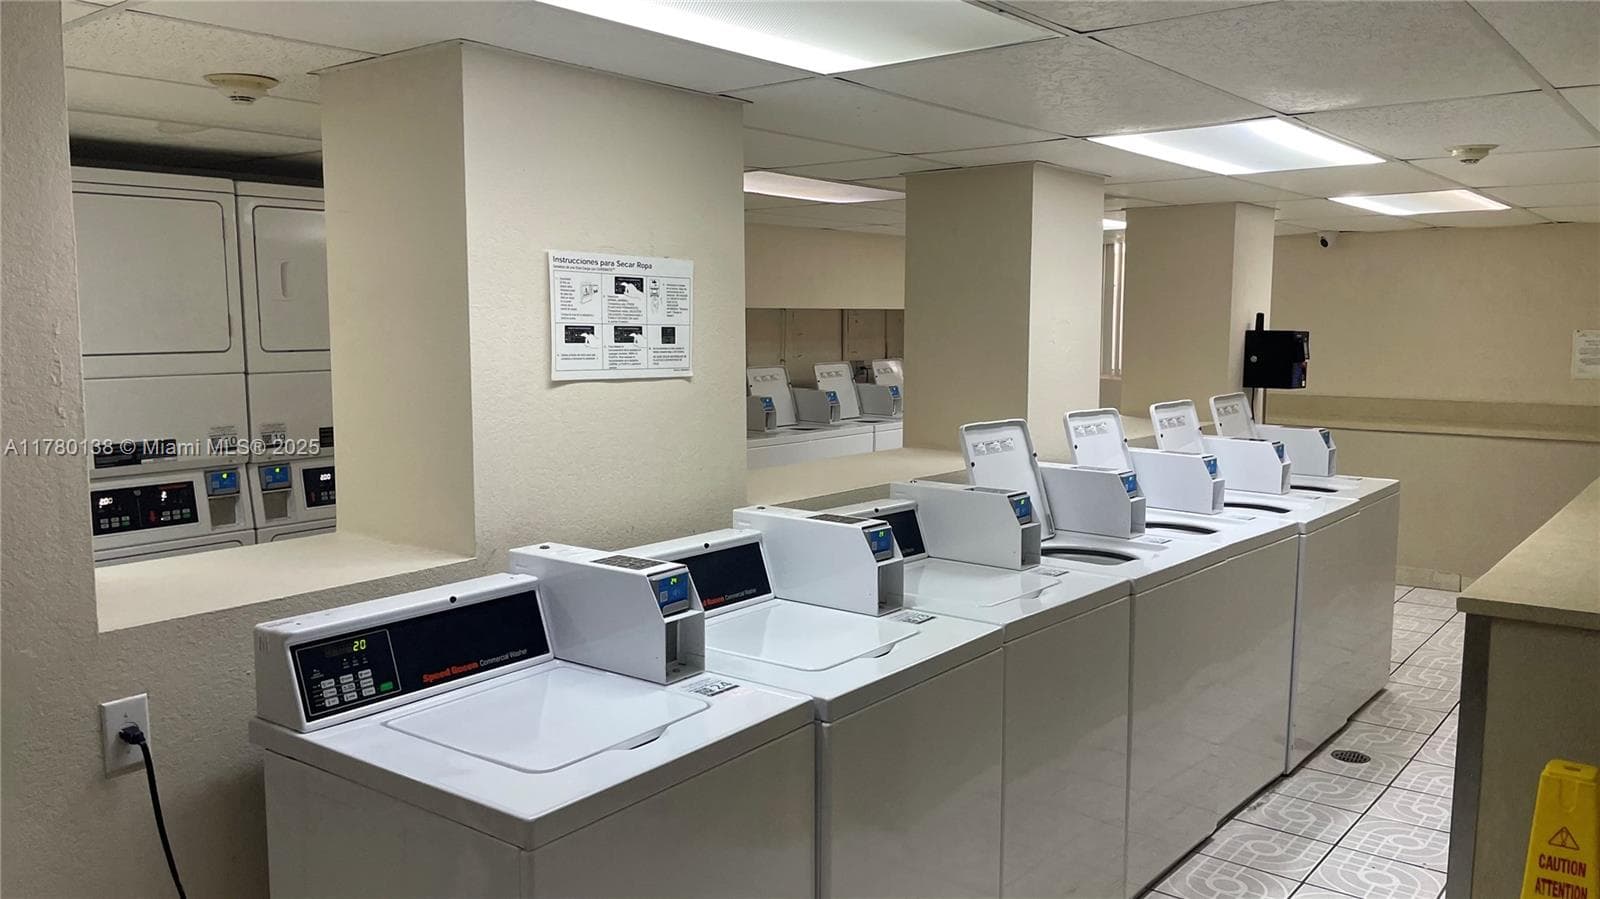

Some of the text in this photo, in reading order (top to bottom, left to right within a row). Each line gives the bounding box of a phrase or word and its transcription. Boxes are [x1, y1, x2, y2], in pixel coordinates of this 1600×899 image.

[553, 256, 652, 270] Instrucciones para Secar Ropa
[352, 639, 367, 651] 20
[422, 667, 451, 683] Speed
[479, 653, 509, 667] Commercial
[510, 648, 528, 658] Washer
[1538, 853, 1587, 878] CAUTION
